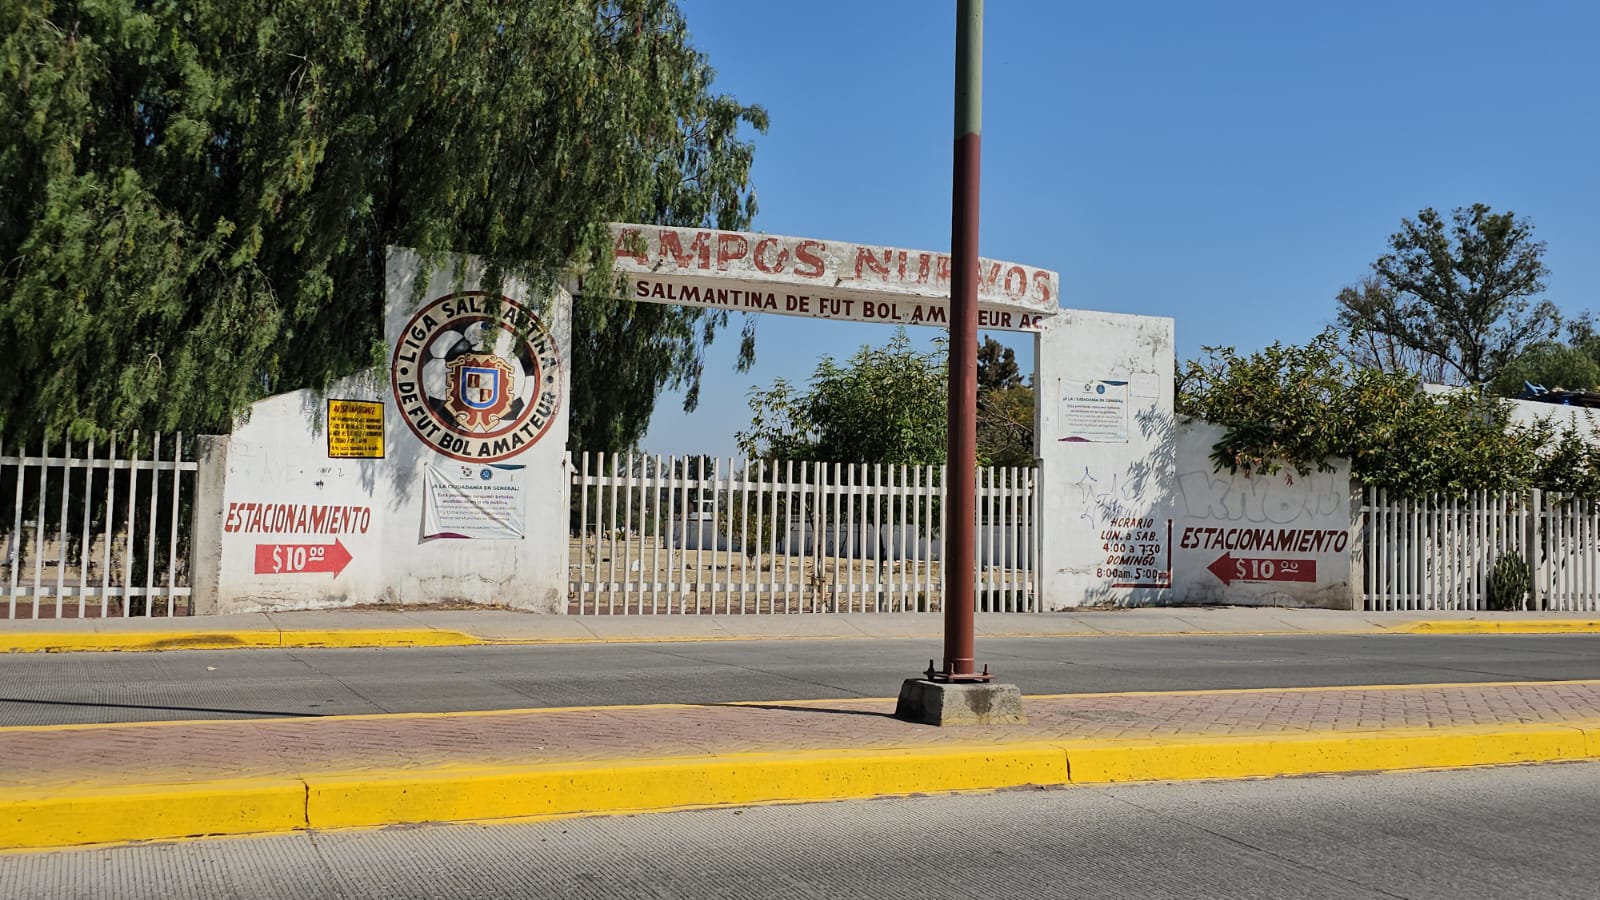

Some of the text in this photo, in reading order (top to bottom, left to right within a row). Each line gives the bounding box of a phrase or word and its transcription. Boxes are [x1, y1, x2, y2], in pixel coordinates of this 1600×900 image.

[614, 228, 826, 279] AMPOS
[636, 280, 777, 310] SALMANTINA
[786, 294, 809, 313] DE
[819, 297, 855, 316] FUT
[863, 301, 902, 320] BOL
[911, 305, 1012, 328] AMEUR
[399, 314, 439, 364] LIGA
[398, 381, 557, 457] DE FUT BOL AMATEUR
[224, 502, 371, 534] ESTACIONAMIENTO
[1110, 517, 1154, 529] HORARIO
[1101, 530, 1159, 542] LUN. a SAB.
[1129, 545, 1135, 553] a
[1180, 527, 1349, 553] ESTACIONAMIENTO
[1106, 555, 1156, 566] DOMINGO
